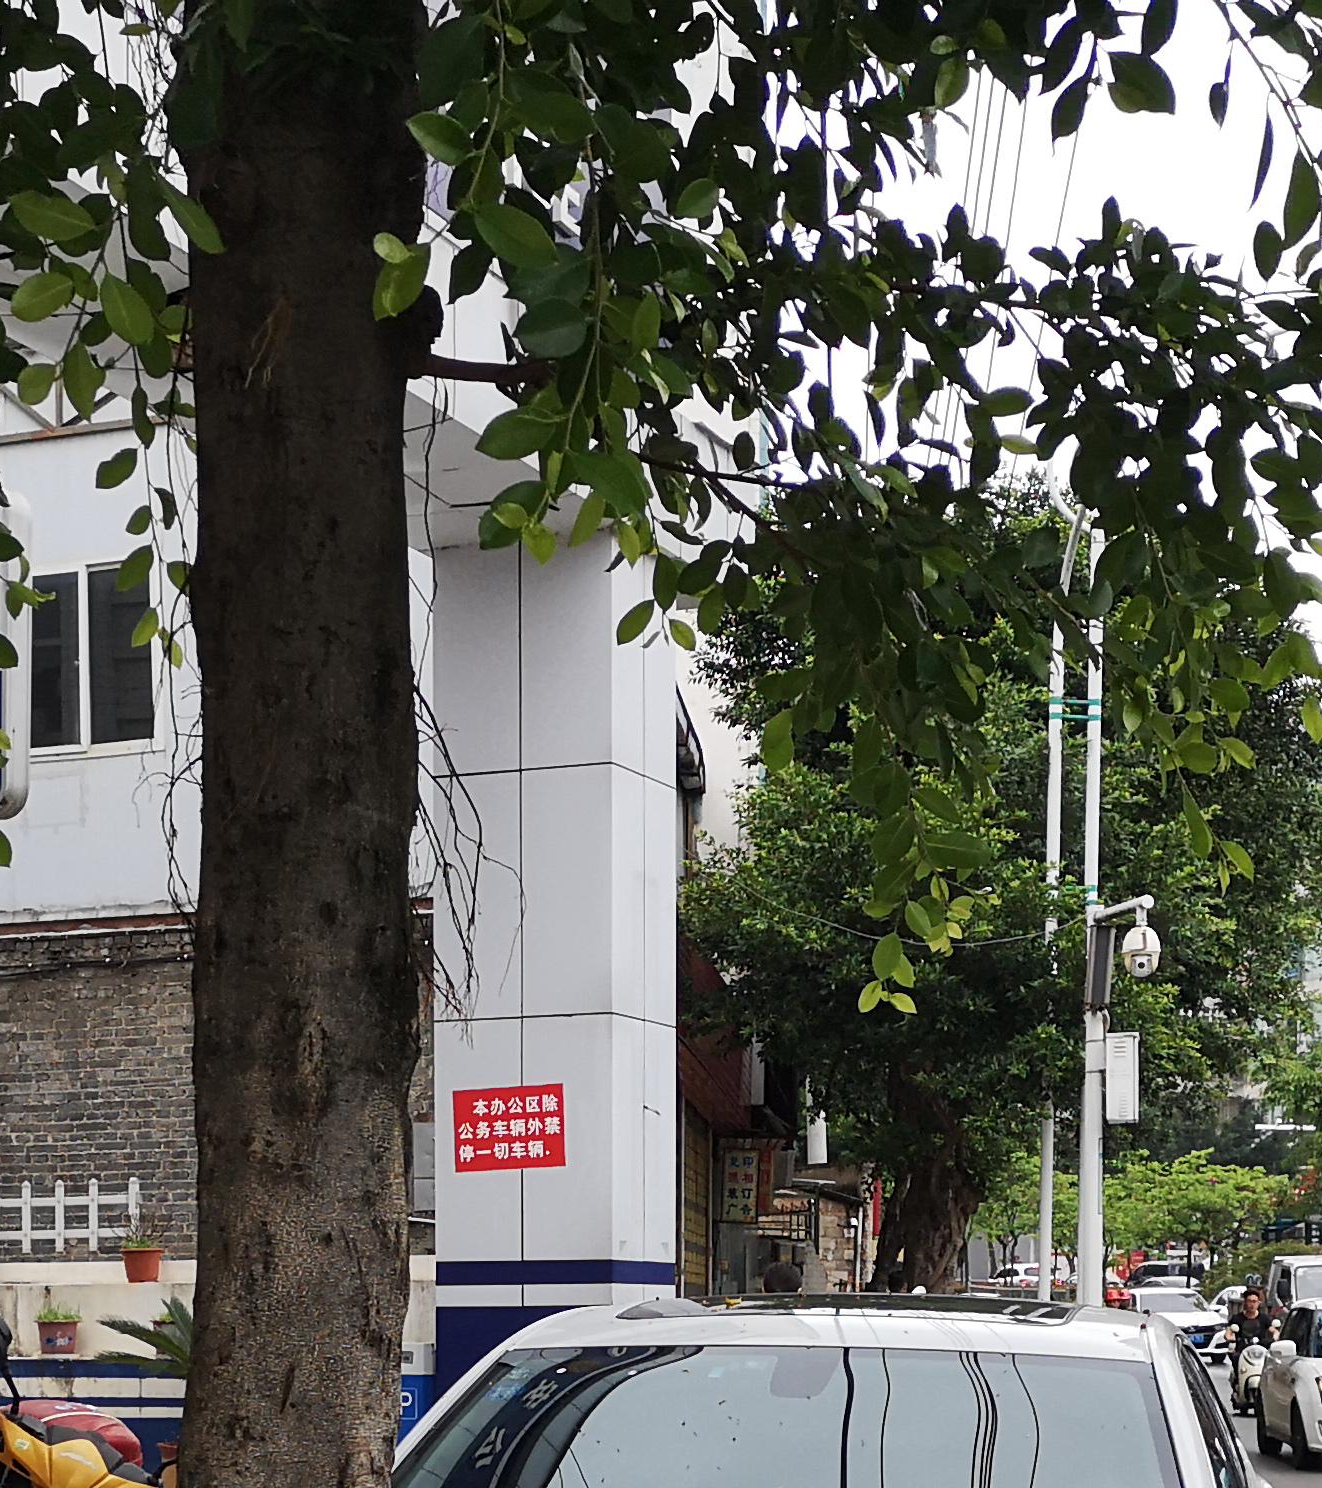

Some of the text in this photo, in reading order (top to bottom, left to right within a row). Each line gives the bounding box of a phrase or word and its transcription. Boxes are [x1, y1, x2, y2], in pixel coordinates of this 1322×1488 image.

[473, 1094, 559, 1117] 本办公区除
[458, 1116, 561, 1139] 公务车辆外禁
